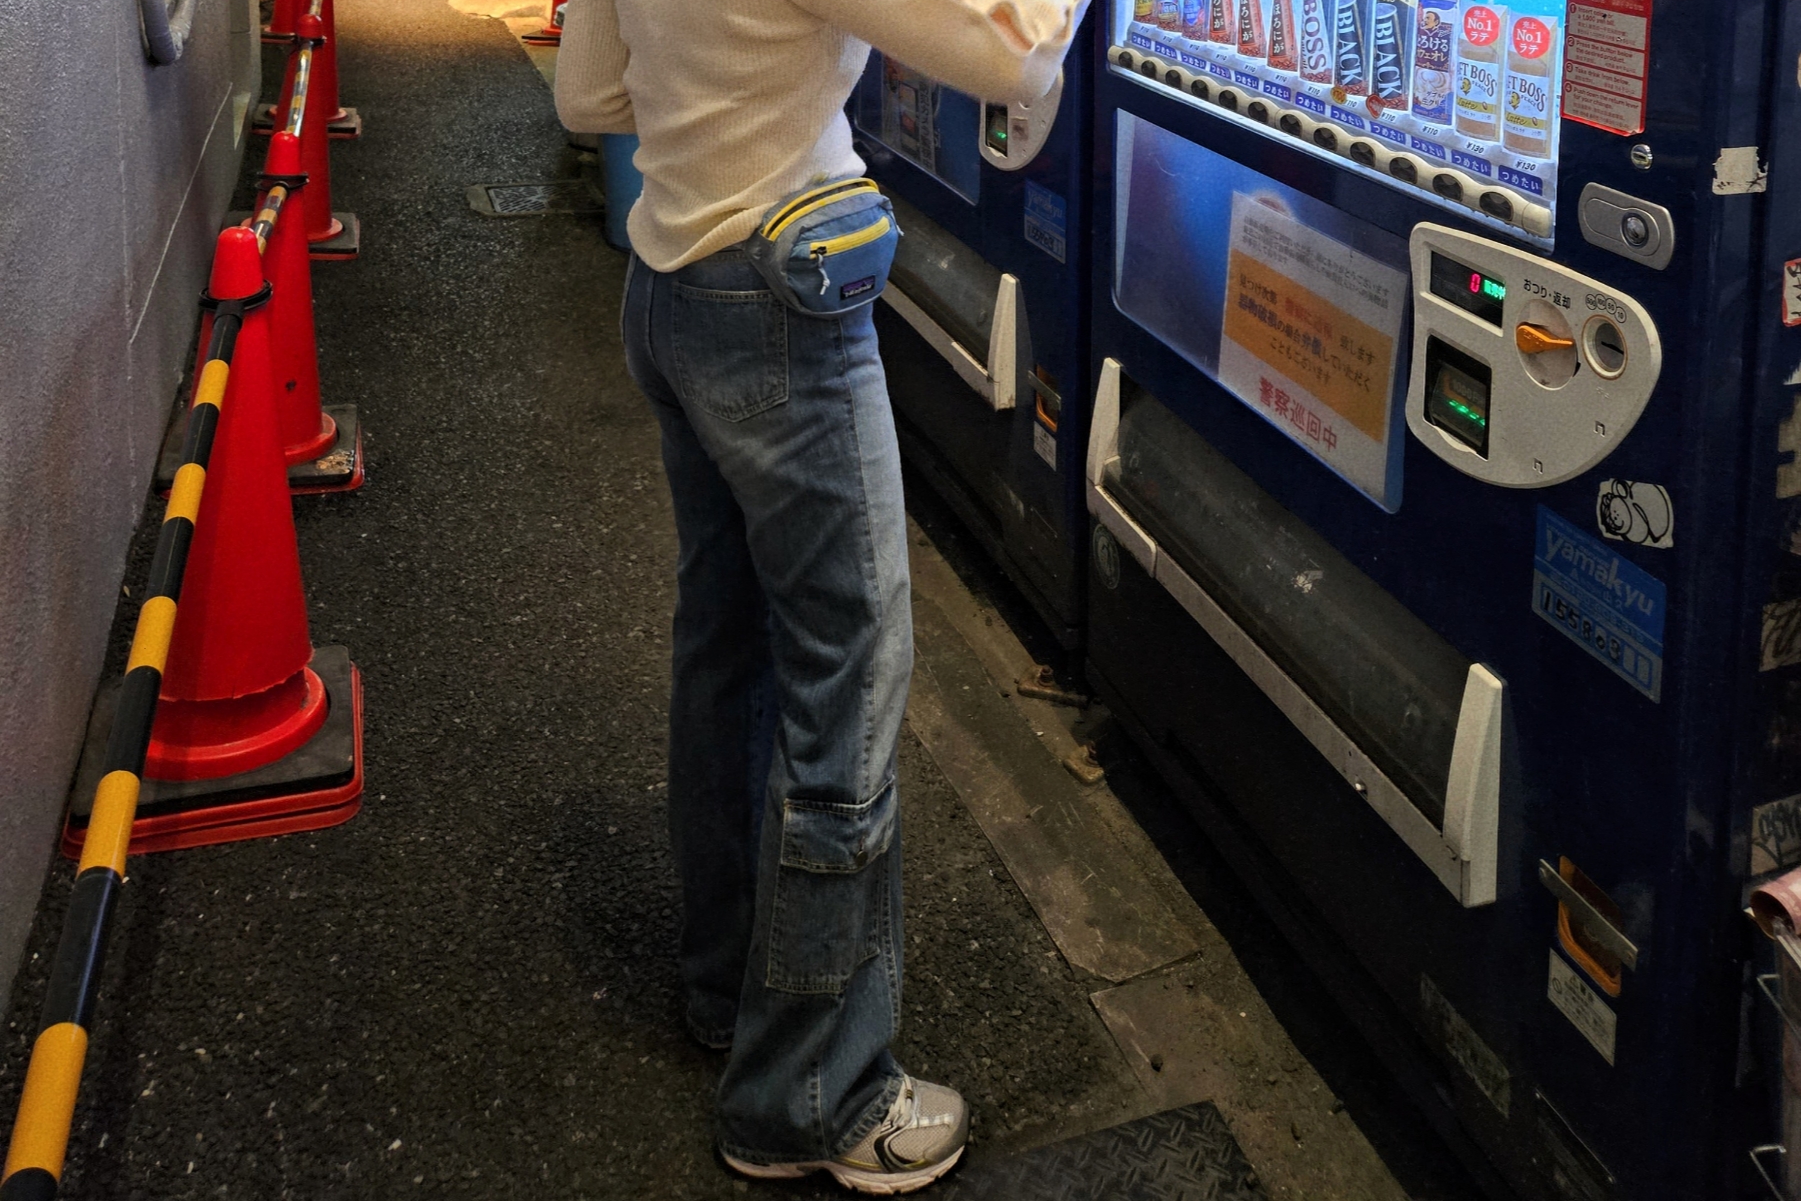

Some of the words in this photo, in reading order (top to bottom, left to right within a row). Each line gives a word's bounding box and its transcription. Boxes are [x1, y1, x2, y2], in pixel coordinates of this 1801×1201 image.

[1473, 10, 1488, 18] 売上
[1466, 17, 1493, 31] No.1
[1522, 21, 1536, 30] 売上
[1470, 32, 1490, 42] ラテ
[1516, 29, 1542, 44] No.1
[1337, 9, 1364, 86] BLACK
[1519, 43, 1538, 55] ラテ
[1576, 40, 1591, 48] Press
[1600, 45, 1617, 54] button
[1617, 50, 1633, 58] below
[1376, 21, 1403, 98] BLACK
[1470, 63, 1498, 98] BOSS
[1575, 66, 1587, 74] Take
[1602, 72, 1614, 81] from
[1265, 84, 1289, 98] つめたい
[1308, 87, 1321, 96] ¥110
[1519, 77, 1547, 113] BOSS
[1573, 86, 1586, 95] Push
[1609, 97, 1625, 105] return
[1625, 101, 1639, 109] lever
[1298, 96, 1324, 112] つめたい
[1581, 95, 1593, 104] your
[1333, 110, 1363, 126] つめたい
[1381, 112, 1396, 122] ¥110
[1373, 122, 1404, 140] つめたい
[1422, 125, 1439, 136] ¥110
[1466, 142, 1485, 154] ¥130
[1454, 154, 1488, 173] つめたい
[1515, 160, 1536, 171] ¥130
[1502, 170, 1539, 190] つめたい
[1469, 273, 1481, 293] 0
[1523, 278, 1571, 309] おつり・返却
[1239, 273, 1278, 306] 見つけ次第
[1339, 335, 1376, 366] 致します
[1259, 376, 1338, 452] 警察巡回中
[1545, 521, 1654, 616] yamakyu
